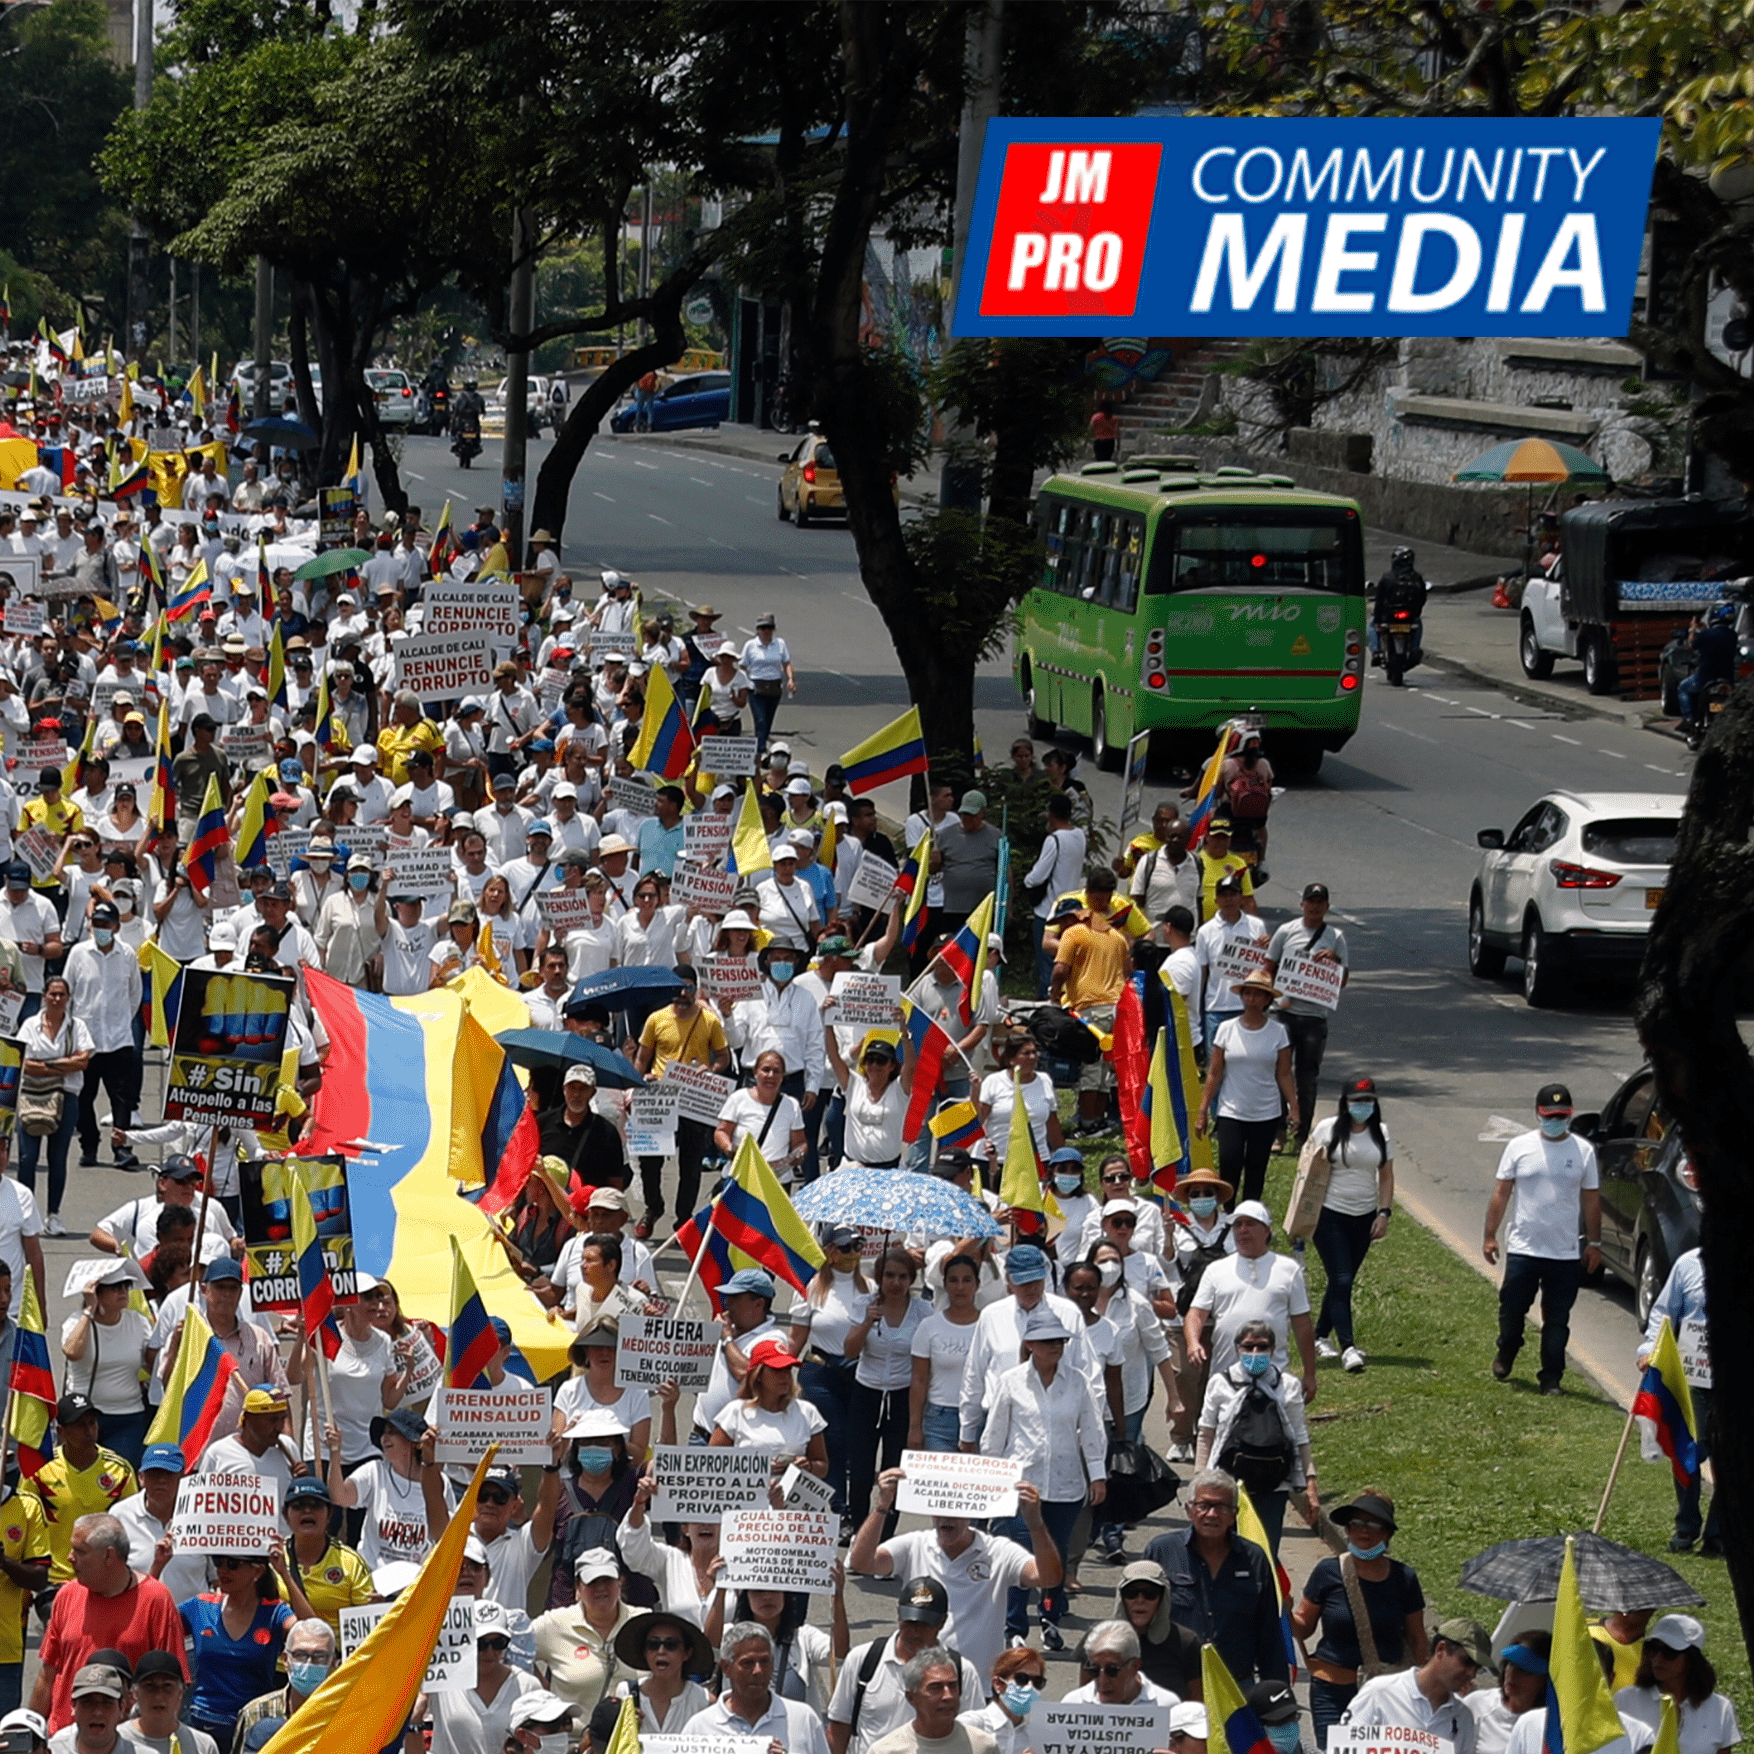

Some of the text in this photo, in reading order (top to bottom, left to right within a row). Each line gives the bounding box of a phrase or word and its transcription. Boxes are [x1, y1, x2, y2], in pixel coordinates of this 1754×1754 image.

[430, 593, 514, 604] ALCALDE CALI
[433, 606, 511, 621] RENUNCIE
[399, 640, 485, 659] ALCALDE CALI
[403, 654, 484, 677] RENUNCIE
[212, 1067, 261, 1094] Sin
[168, 1087, 273, 1113] Atropello las
[182, 1107, 254, 1129] Pensiones
[643, 1318, 704, 1342] #FUERA
[621, 1335, 717, 1358] MÉDICOS CUBANOS
[655, 1359, 699, 1374] COLOMBIA
[620, 1369, 709, 1387] TENEMOS MEJORES
[444, 1392, 546, 1407] #RENUNCIE
[449, 1409, 542, 1423] MINSALUD
[655, 1450, 769, 1474] #SIN EXPROPIACIÓN
[209, 1473, 262, 1489] ROBARSE
[656, 1475, 726, 1487] RESPETO
[193, 1488, 275, 1517] PENSIÓN
[668, 1488, 757, 1502] PROPIEDAD
[185, 1524, 277, 1537] MI DERECHO
[737, 1522, 785, 1533] PRECIO
[180, 1536, 262, 1548] ADQUIRIDO
[726, 1533, 834, 1547] GASOLINA PARA?
[771, 1574, 834, 1588] ELÉCTRICAS
[1350, 1726, 1440, 1750] #SIN ROBARSE
